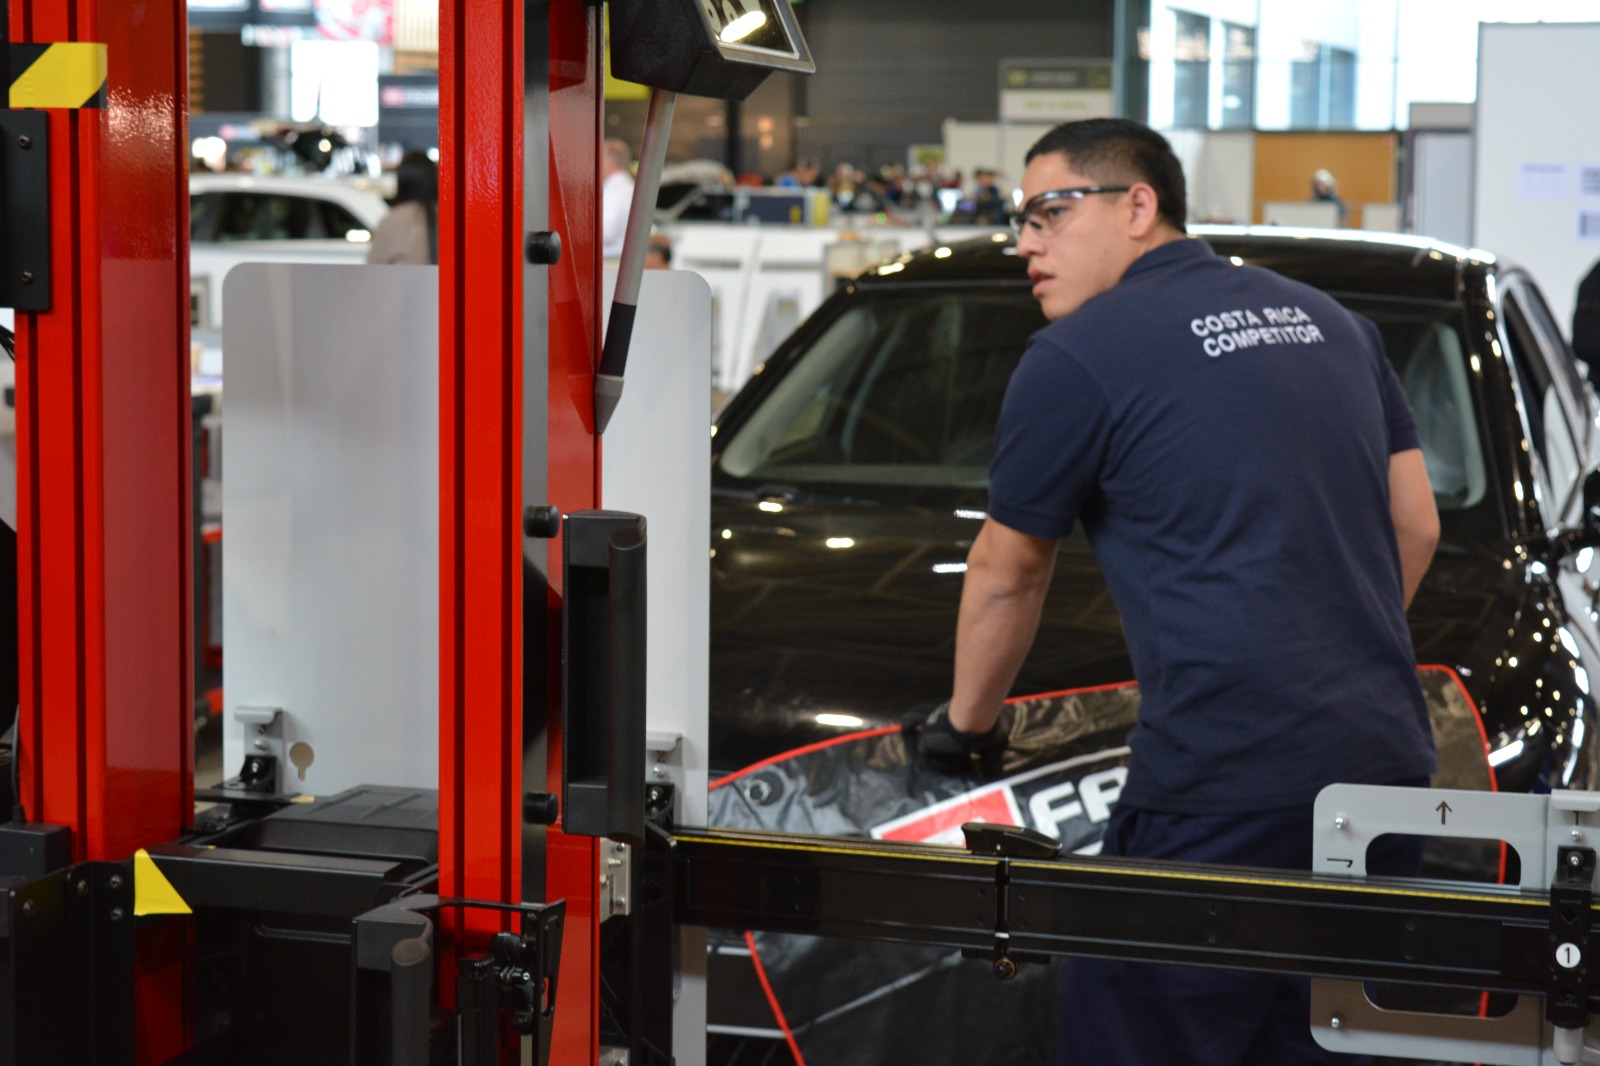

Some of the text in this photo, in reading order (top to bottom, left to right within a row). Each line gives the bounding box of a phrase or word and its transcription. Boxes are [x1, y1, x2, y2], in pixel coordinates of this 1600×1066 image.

[1190, 306, 1312, 337] COSTA RICA
[1203, 324, 1325, 357] COMPETITOR
